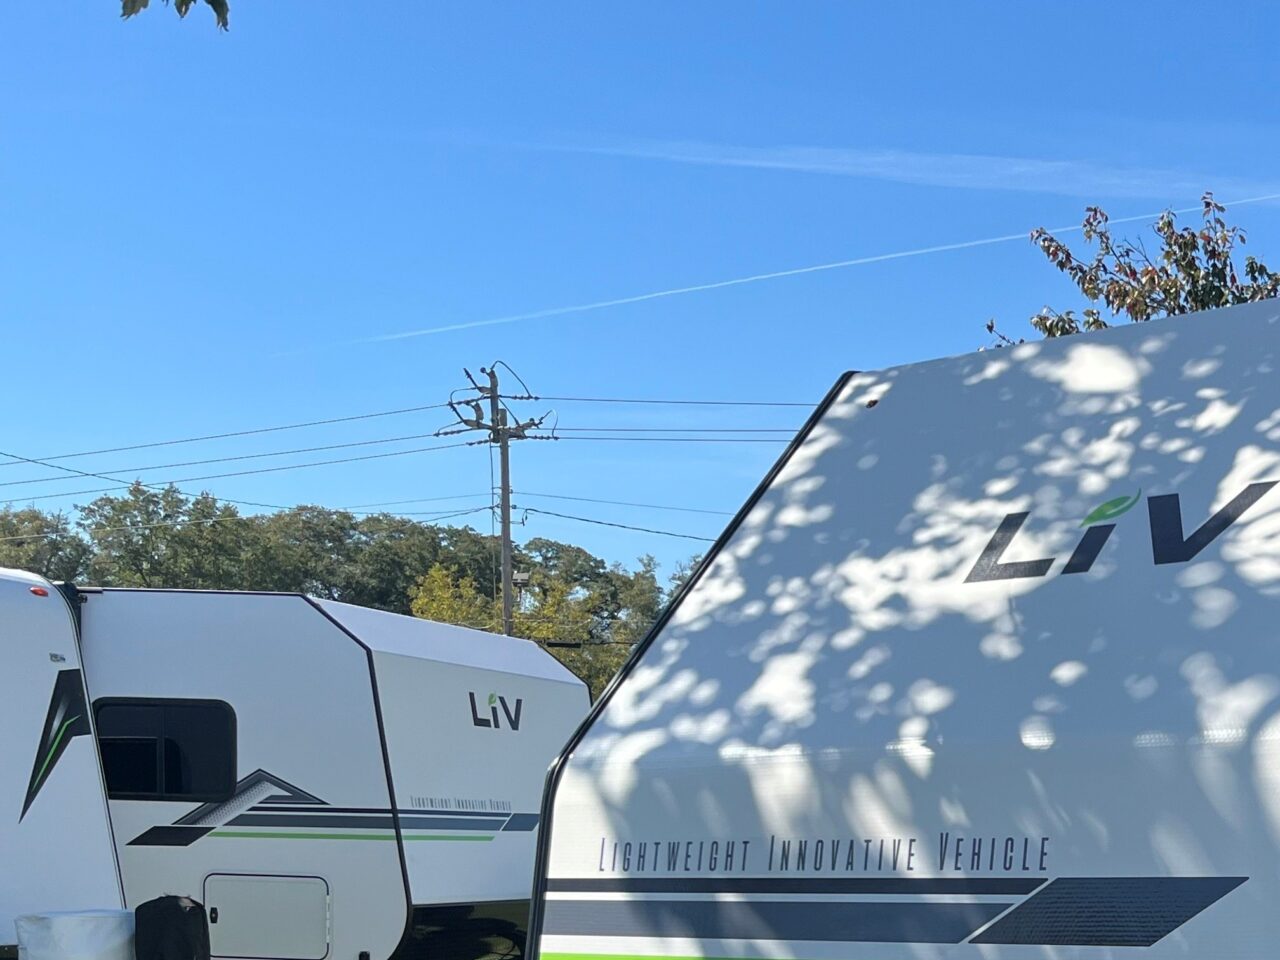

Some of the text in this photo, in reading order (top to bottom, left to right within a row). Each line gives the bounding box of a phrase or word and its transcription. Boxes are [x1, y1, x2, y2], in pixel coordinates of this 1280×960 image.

[599, 832, 1049, 872] LIGHTWEIGHT INNOVATIVE VEHICLE
